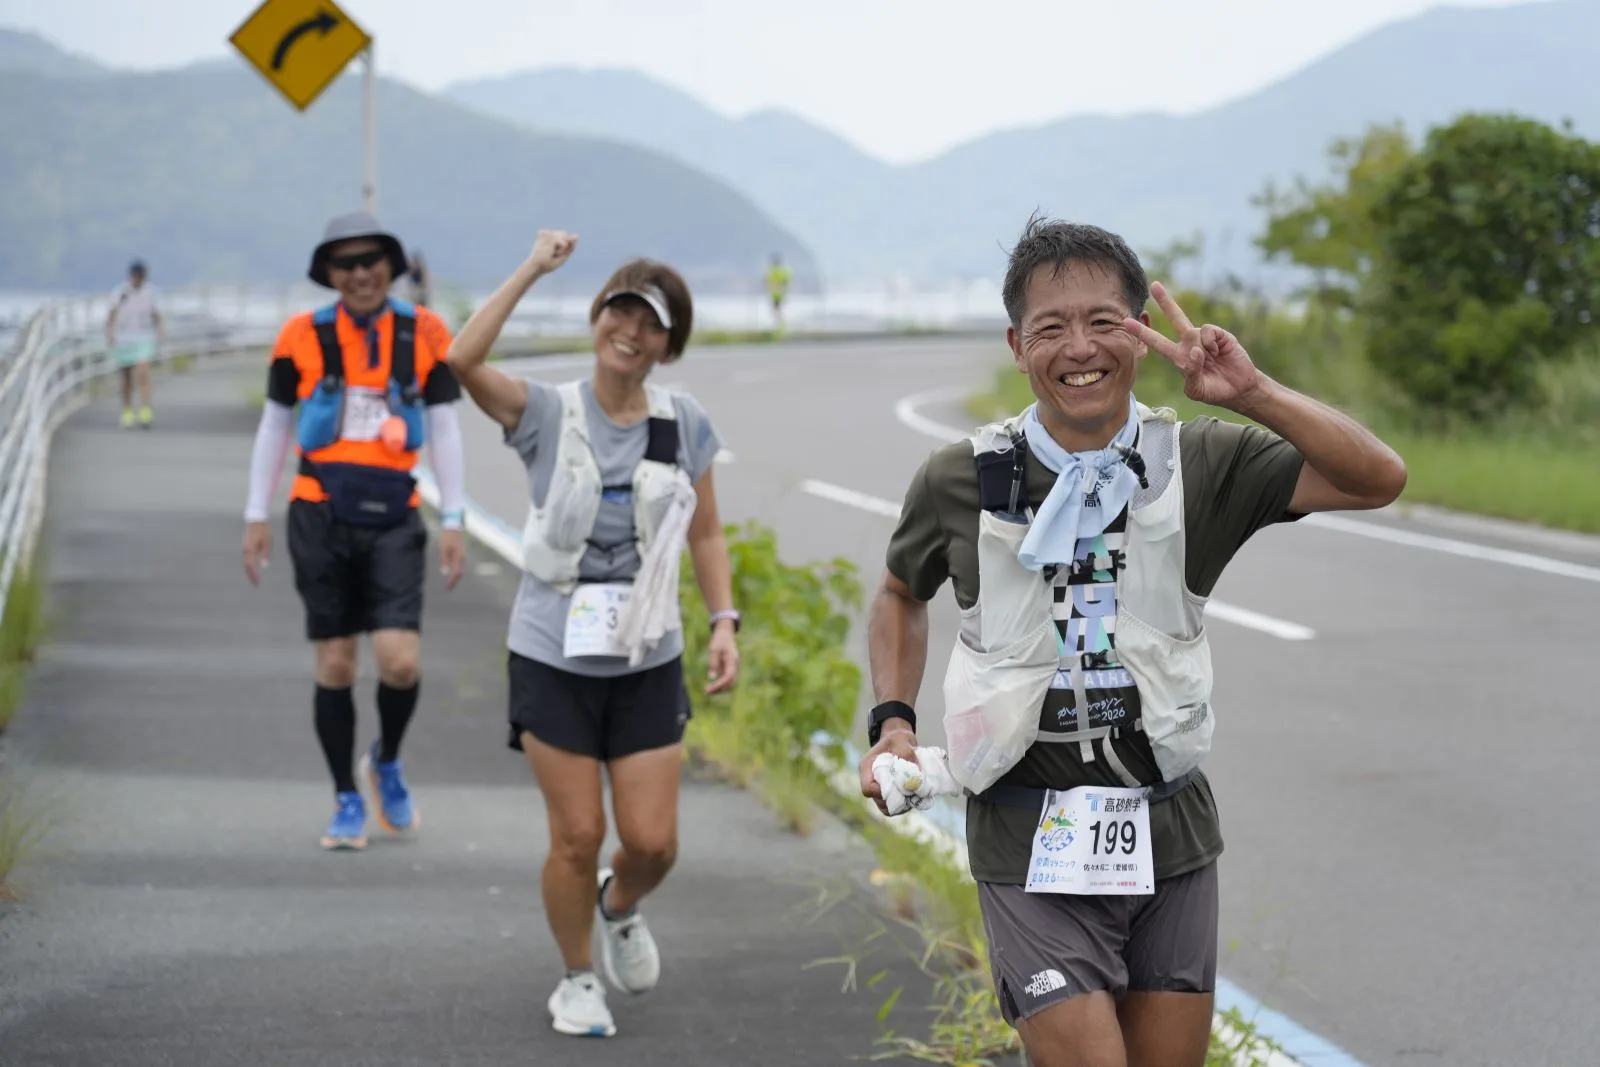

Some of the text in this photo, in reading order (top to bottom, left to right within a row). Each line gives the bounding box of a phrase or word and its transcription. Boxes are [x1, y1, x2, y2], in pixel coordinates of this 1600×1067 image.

[1101, 707, 1126, 721] 2026
[1089, 820, 1137, 855] 199
[1031, 872, 1057, 883] 2026
[1031, 970, 1047, 983] THE
[1024, 976, 1050, 995] NORTH
[1032, 985, 1053, 998] FACE
